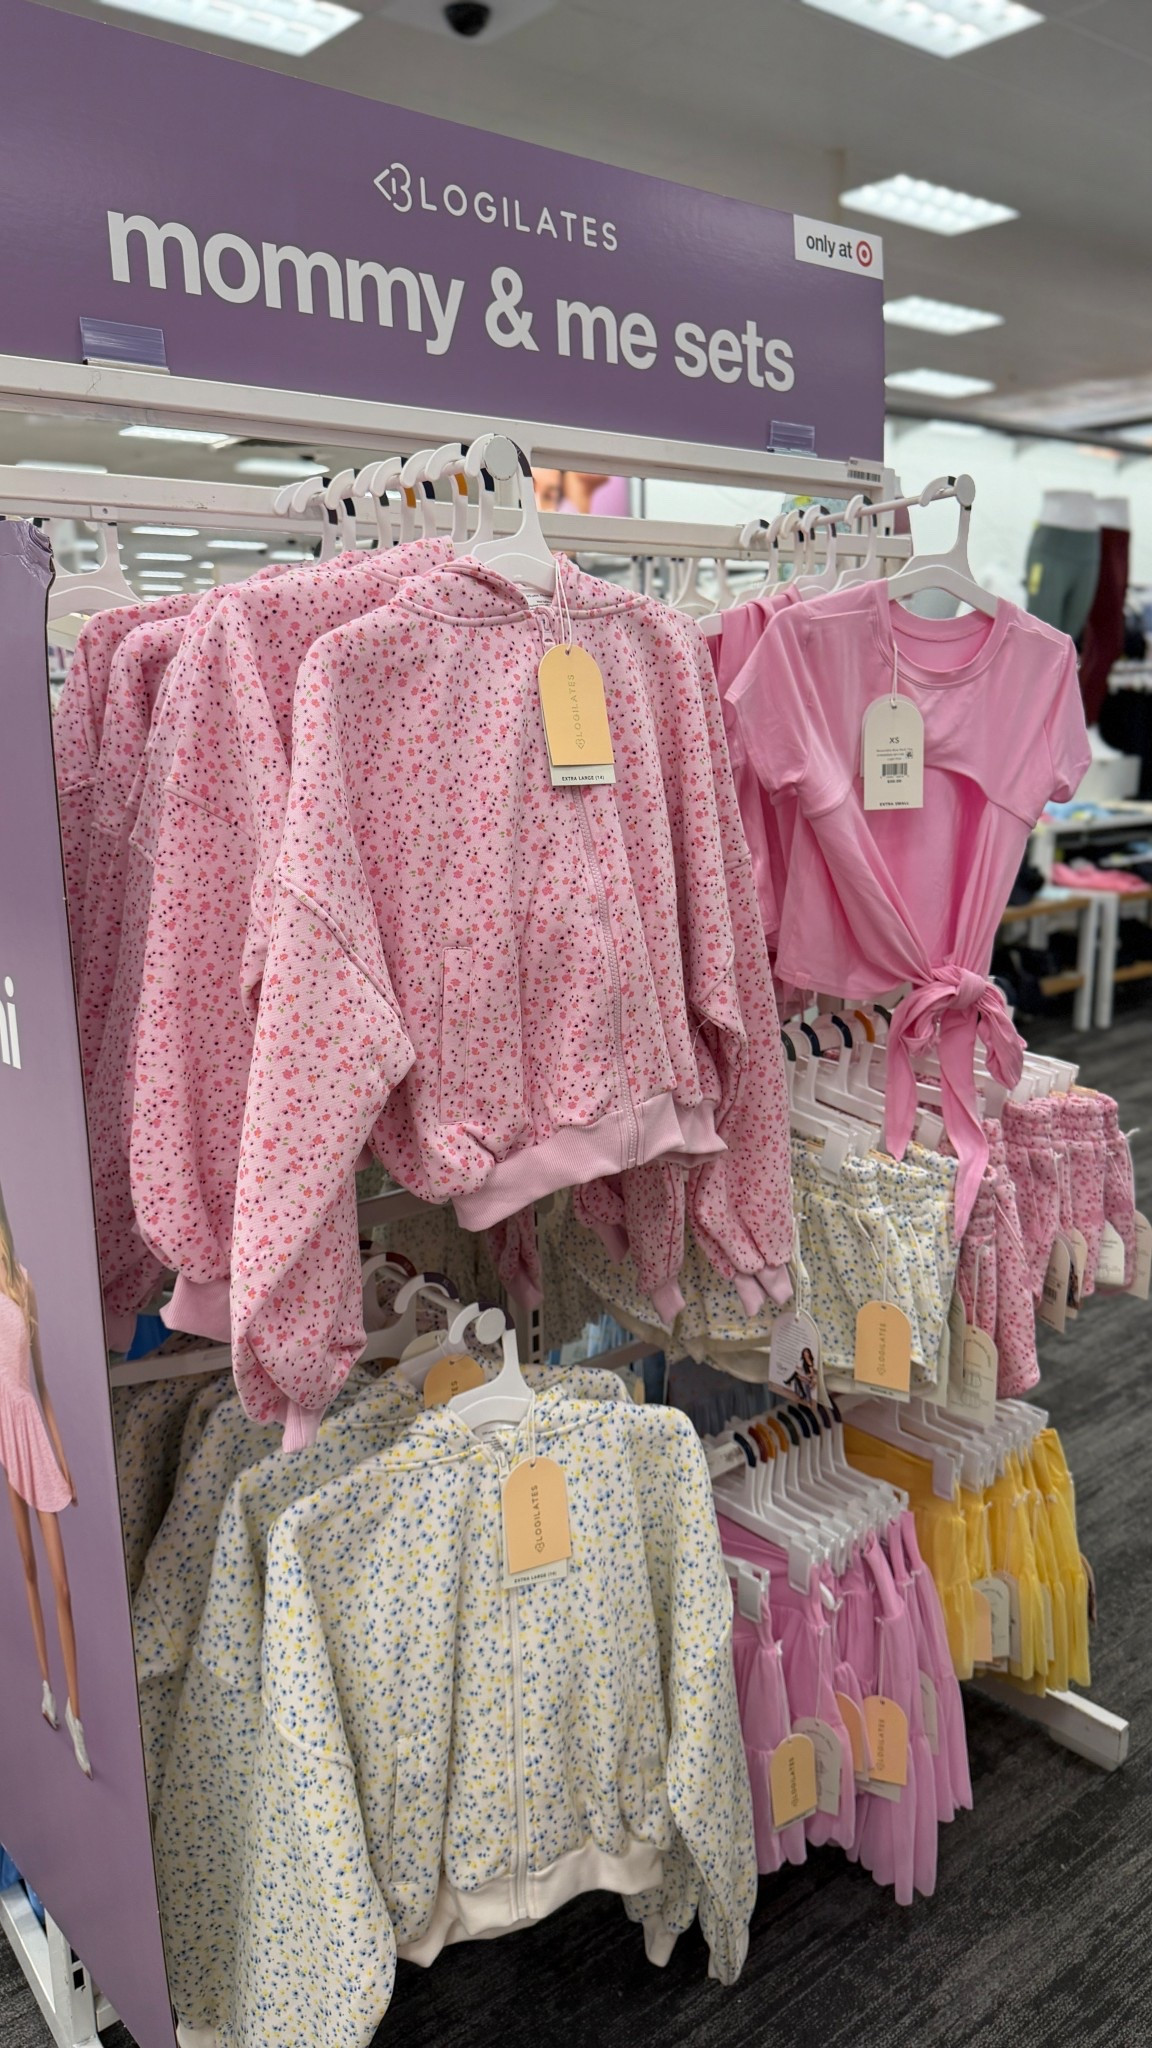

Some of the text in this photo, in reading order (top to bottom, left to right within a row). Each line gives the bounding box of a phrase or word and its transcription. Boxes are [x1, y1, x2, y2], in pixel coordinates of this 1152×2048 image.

[373, 162, 618, 251] BLOGILATES
[806, 234, 853, 259] only at
[107, 210, 796, 392] mommy & me sets
[567, 674, 586, 750] BLOGILATES
[531, 1485, 546, 1553] BLOGILATES
